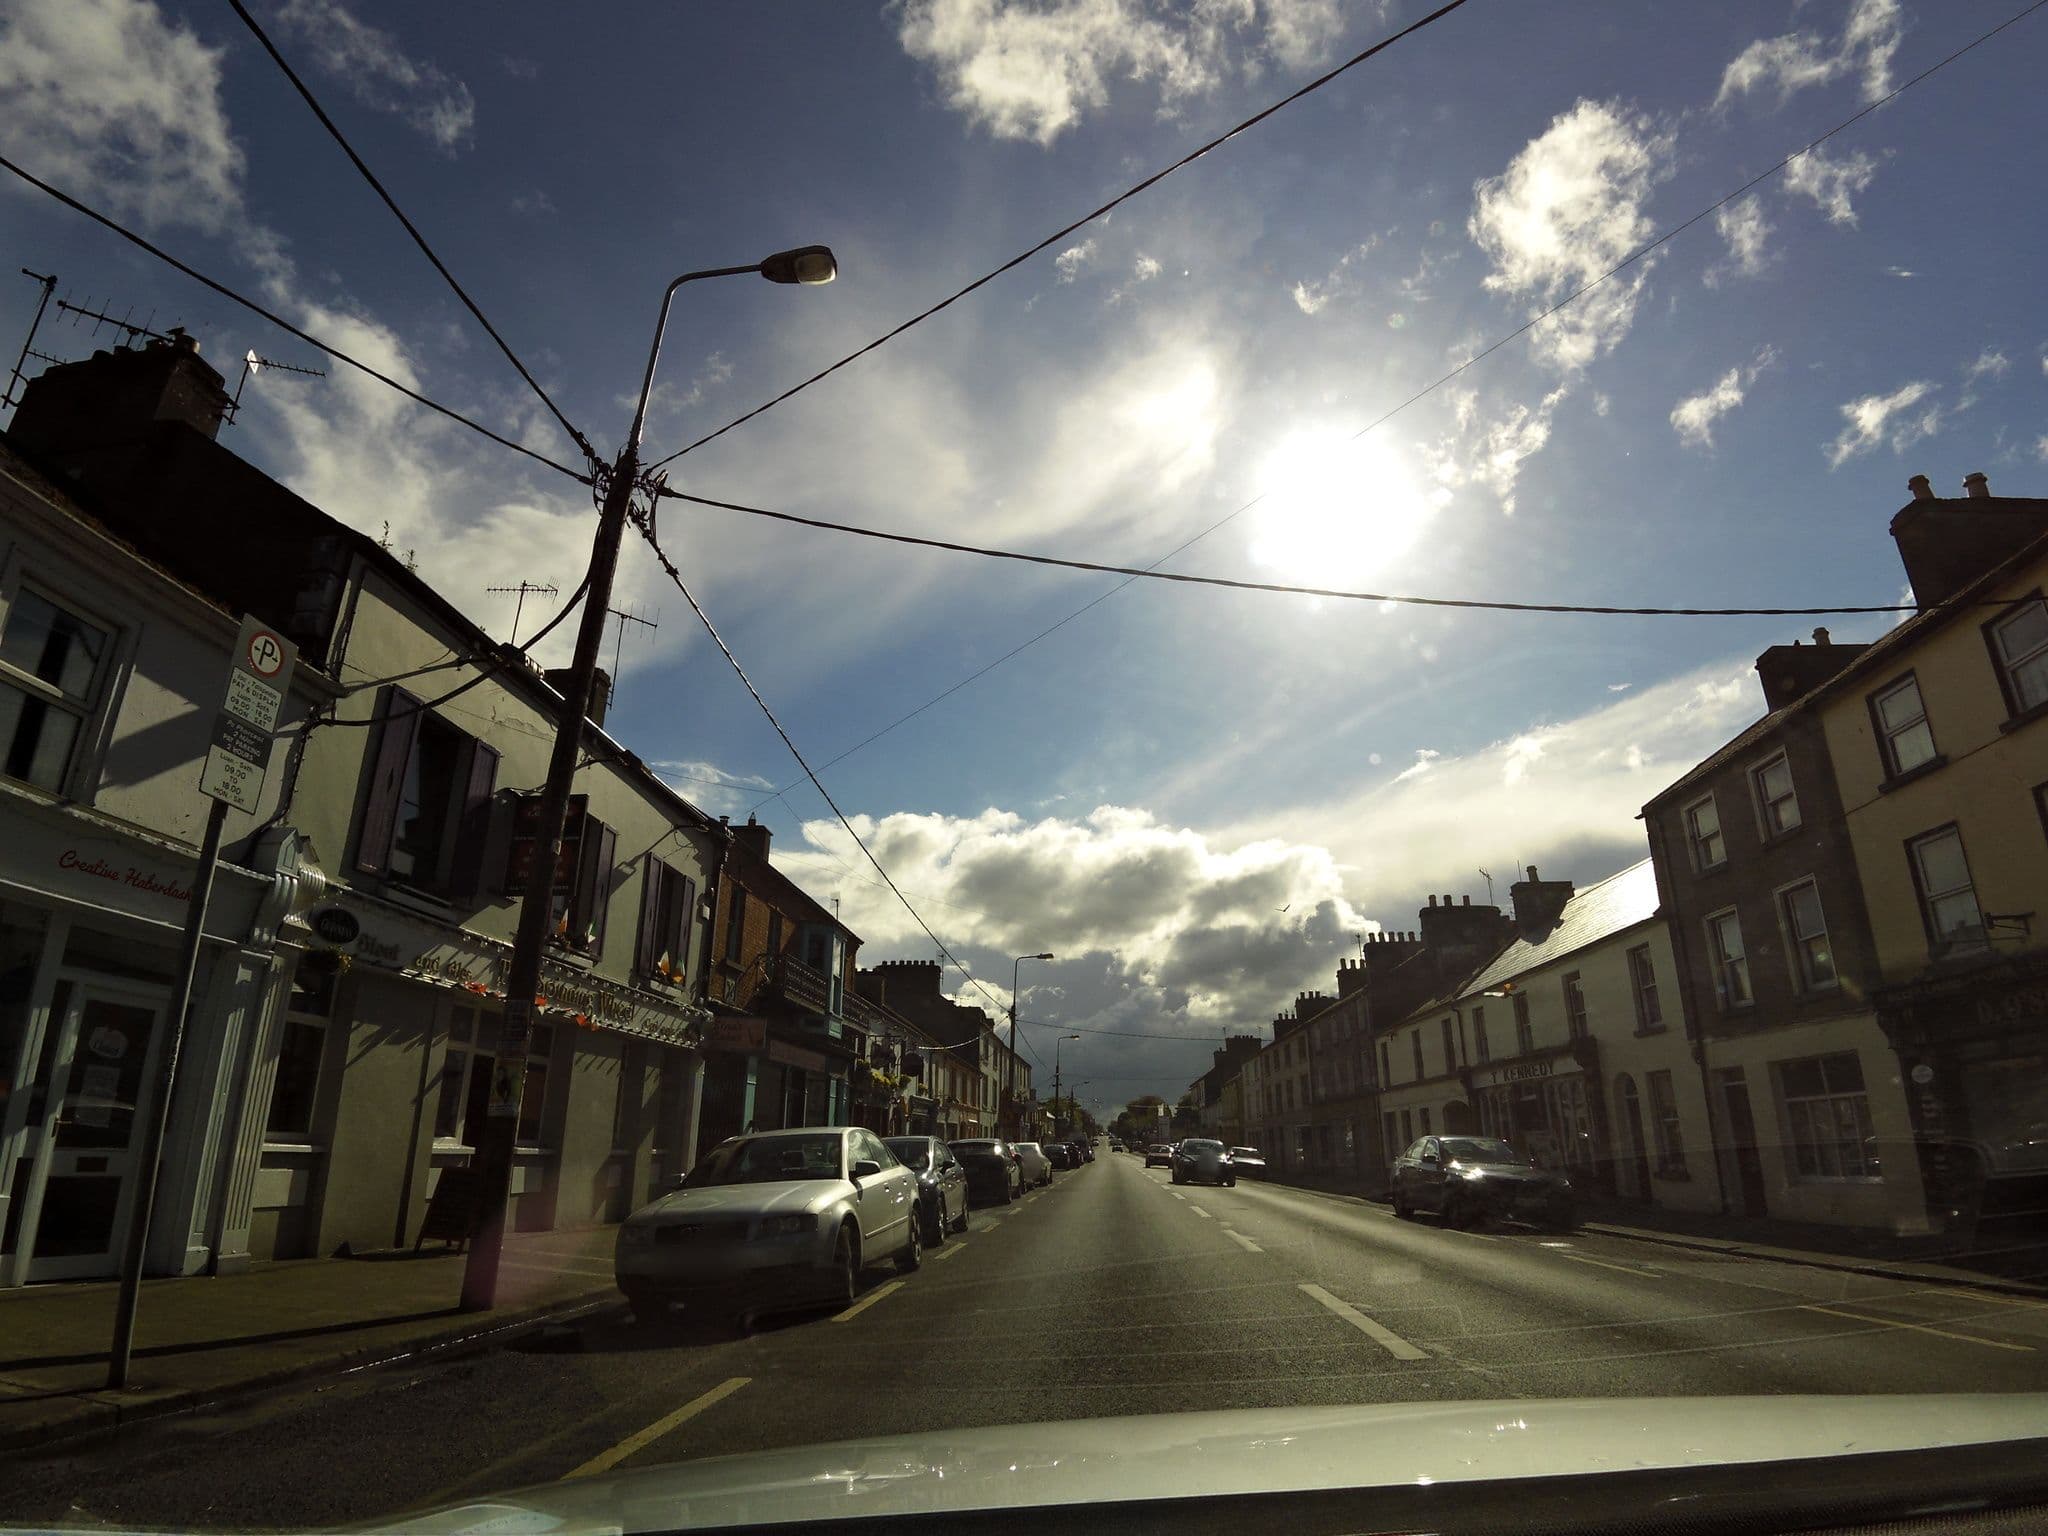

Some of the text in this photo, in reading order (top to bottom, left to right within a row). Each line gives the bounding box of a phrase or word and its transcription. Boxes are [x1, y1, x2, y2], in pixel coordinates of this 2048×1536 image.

[232, 679, 246, 689] PAY
[251, 691, 279, 709] DISPLAY
[232, 706, 267, 728] MON SAT
[232, 747, 255, 762] HOURS
[235, 740, 262, 757] PARKING
[224, 764, 248, 780] 09.00
[221, 781, 243, 796] 18.00
[228, 776, 239, 785] TO
[213, 787, 229, 798] MON
[59, 850, 120, 881] Creative
[1504, 1061, 1553, 1081] KENNEDY
